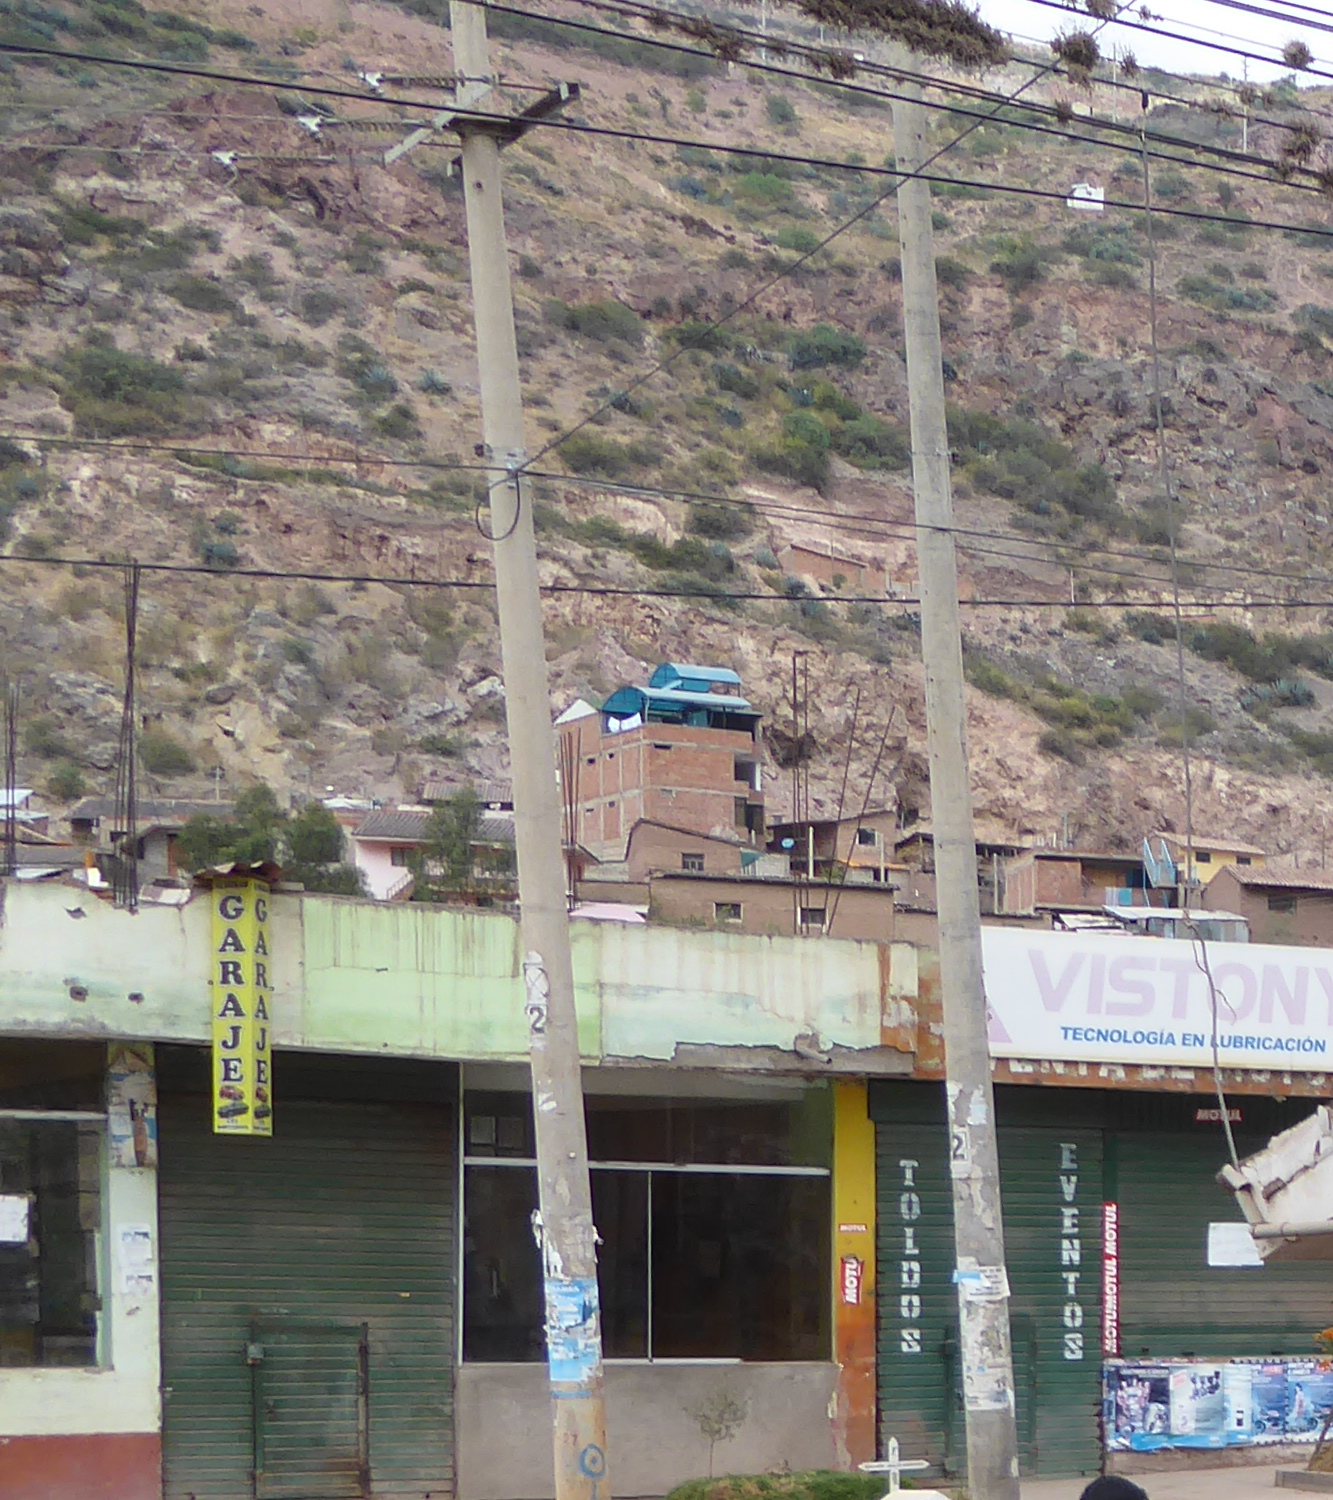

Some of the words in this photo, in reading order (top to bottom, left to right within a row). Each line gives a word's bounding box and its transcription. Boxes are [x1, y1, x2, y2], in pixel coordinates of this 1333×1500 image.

[218, 895, 246, 1083] GARAJE
[254, 898, 269, 1085] GARAJE
[529, 1006, 545, 1034] 2
[1060, 1026, 1177, 1046] TECNOLOGÍA
[1181, 1032, 1205, 1048] EN
[1210, 1034, 1327, 1053] LUBRICACIÓN
[952, 1134, 965, 1160] 2
[844, 1257, 859, 1304] MOTU
[899, 1159, 922, 1353] TOLDOS
[1059, 1142, 1084, 1361] EVENTOS
